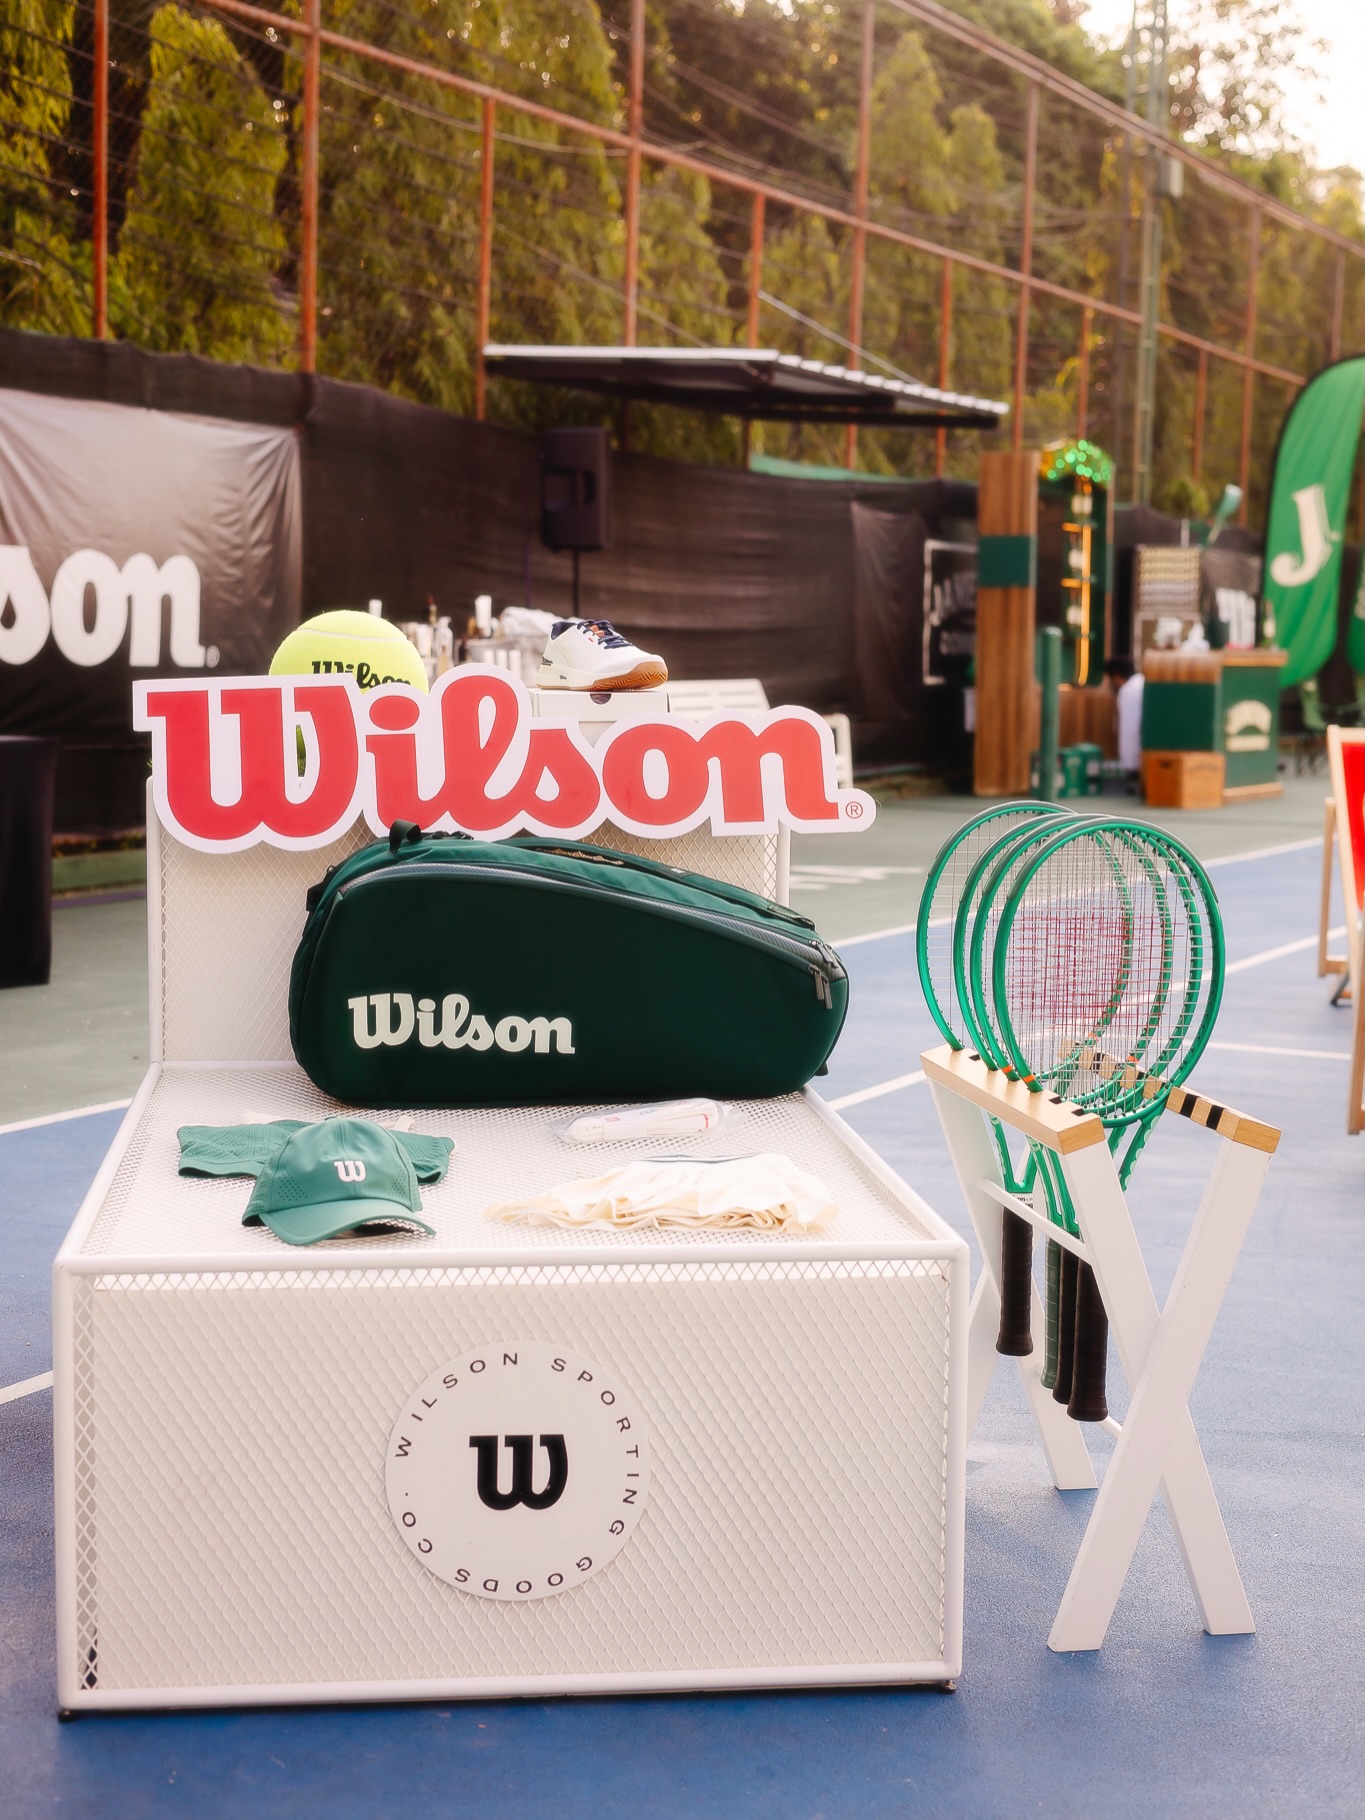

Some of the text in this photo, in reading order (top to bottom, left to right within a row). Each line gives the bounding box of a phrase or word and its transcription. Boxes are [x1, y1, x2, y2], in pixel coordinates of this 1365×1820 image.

[147, 675, 840, 840] Wilson
[348, 993, 575, 1054] Wilson
[334, 1160, 367, 1182] W
[395, 1353, 518, 1458] WILSON
[469, 1434, 568, 1511] W
[551, 1358, 640, 1536] SPORTING
[454, 1556, 593, 1594] GOODS
